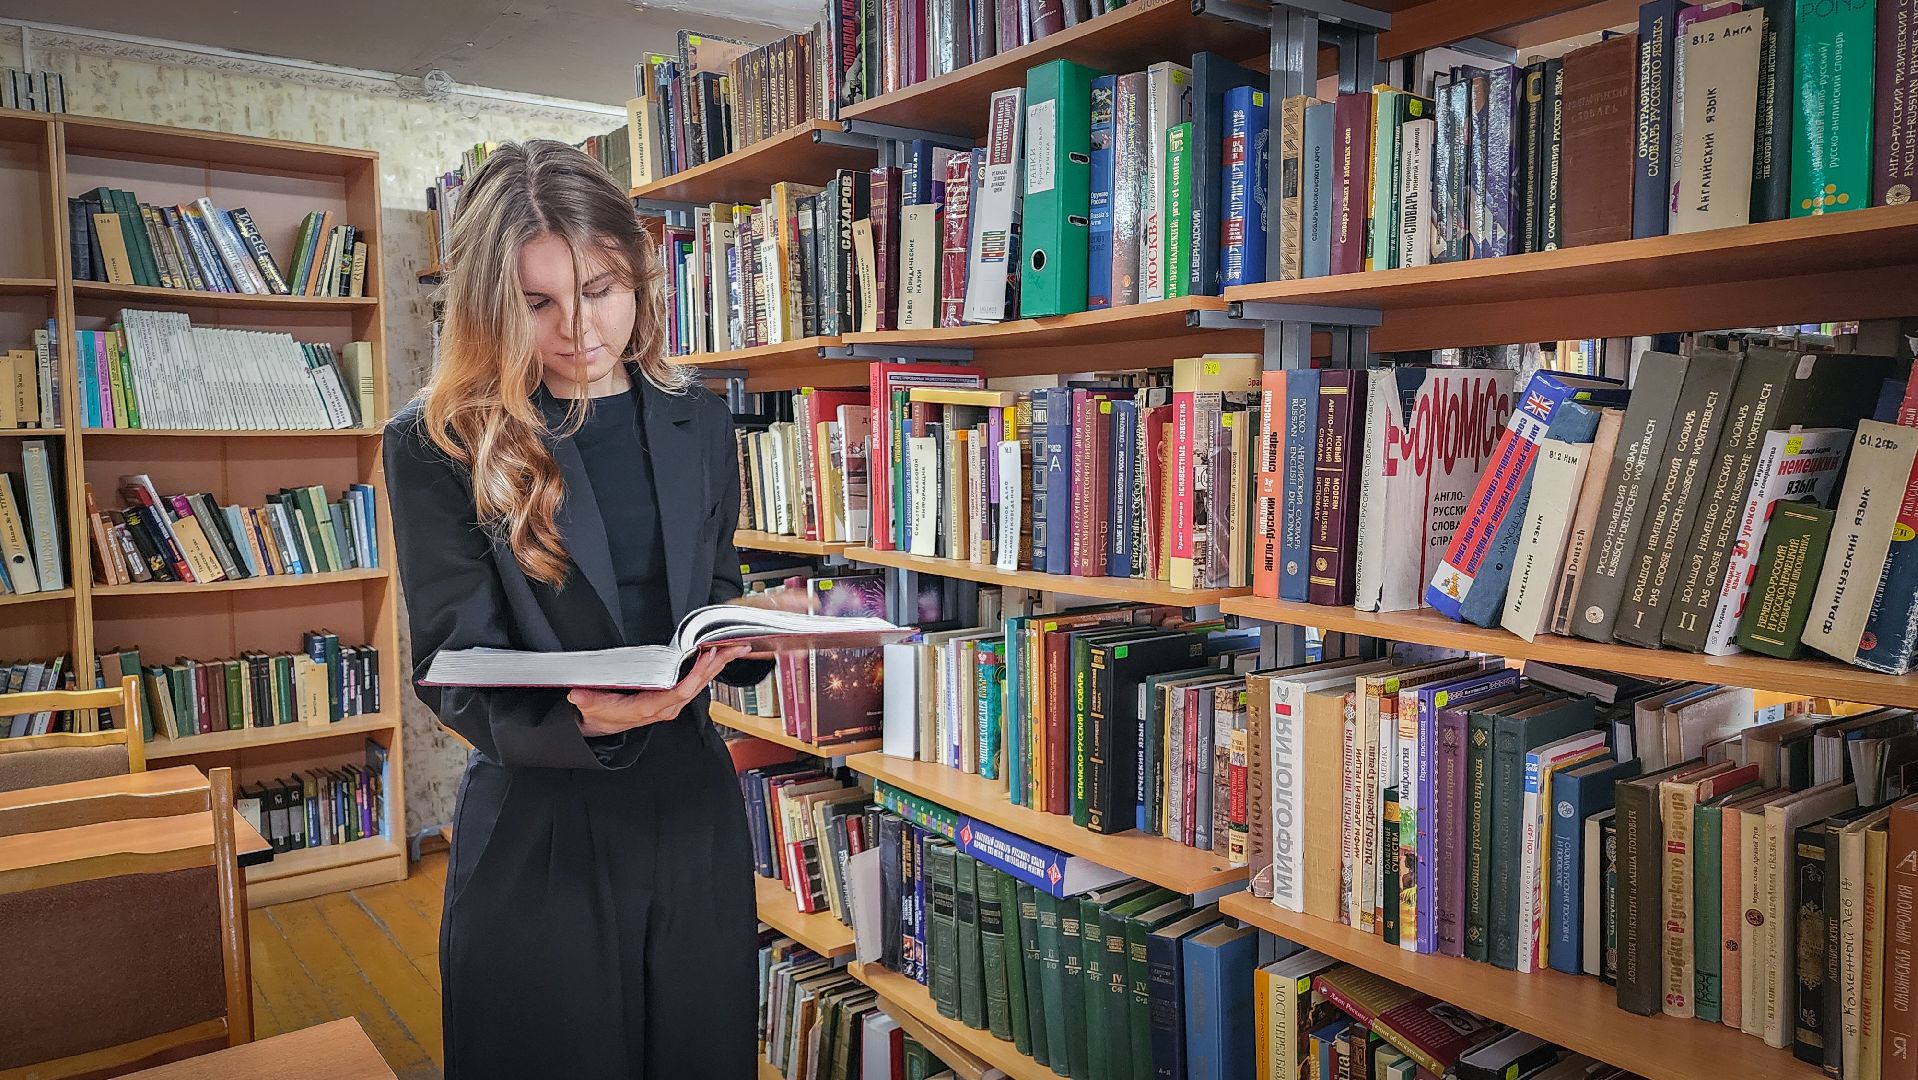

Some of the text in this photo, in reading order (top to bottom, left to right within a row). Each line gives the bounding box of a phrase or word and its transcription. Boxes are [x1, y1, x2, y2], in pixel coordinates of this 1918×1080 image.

[1692, 32, 1716, 46] 81.2
[1894, 8, 1908, 84] ФИЗИЧЕСКИЙ
[1554, 68, 1564, 95] ЯЗЫКА
[1638, 40, 1652, 158] ОРФОГРАФИЧЕСКИЙ
[1647, 16, 1664, 177] СЛОВАРЬ РУССКОГО ЯЗЫКА
[1763, 31, 1778, 179] THE OXFORD RUSSIAN-ENGLISH DICTIONARY
[1828, 31, 1845, 169] русско-английский словарь
[1553, 99, 1563, 141] РУССКОГО
[1888, 86, 1905, 178] АНГЛО-РУССКИЙ
[1903, 79, 1918, 177] ENGLISH-RUSSIAN
[1172, 155, 1181, 186] contra
[841, 175, 852, 250] САХАРОВ
[1190, 209, 1201, 283] В.И.ВЕРНАДСКИЙ
[1339, 212, 1350, 243] Словарь
[1403, 192, 1419, 268] РАТКИЙ СЛОВАРЬ
[1548, 202, 1557, 238] СЛОВАРЬ
[1147, 212, 1159, 289] МОСКВА
[1083, 408, 1093, 460] БИБЛИОТЕК
[1266, 431, 1279, 473] словарь
[1325, 398, 1336, 463] АНГЛО-РУССКИЙ
[1335, 435, 1343, 463] НОВЫЙ
[1505, 424, 1541, 491] АНГЛО-РУССКИЙ
[1082, 462, 1091, 502] ИСТОРИЯ
[1177, 445, 1187, 497] НЕИЗВЕСТНЫЕ
[1286, 398, 1299, 550] RUSSIAN ENGLISH DICTIONARY
[1313, 476, 1323, 521] DICTIONARY
[1331, 477, 1341, 510] MODERN
[1434, 491, 1466, 502] АНГЛО-
[1595, 441, 1640, 575] РУССКО-НЕМЕЦКИЙ СЛОВАРЬ
[1607, 418, 1657, 577] RUSSISCH-DEUTSCHES WÖRTERBUCH
[1632, 409, 1698, 603] БОЛЬШОЙ НЕМЕЦКО-РУССКИЙ СЛОВАРЬ
[1647, 390, 1718, 607] DAS GROSSE DEUTSCH-RUSSISCHE WÖRTERBUCH
[1681, 404, 1751, 603] БОЛЬШОЙ НЕМЕЦКО-РУССКИЙ СЛОВАРЬ
[1696, 382, 1774, 609] DAS GROSSE DEUTSCH-RUSSISCHE WÖRTERBUCH
[1263, 497, 1277, 572] англо-русский
[1320, 477, 1332, 541] ENGLISH-RUSSIAN
[1358, 479, 1371, 550] АНГЛО-РУССКИЙ
[1432, 505, 1467, 517] РУССКИ
[1730, 499, 1761, 560] 30 уроков
[1567, 529, 1586, 572] Deutsch
[1757, 544, 1788, 629] НЕМЕЦКО-РУССКИЙ
[1768, 538, 1800, 623] РУССКО-НЕМЕЦКИЙ
[1777, 534, 1812, 634] СЛОВАРЬ ДЛЯ ШКОЛЬНИКА
[1076, 670, 1085, 801] ИСПАНСКО-РУССКИЙ СЛОВАРЬ
[1137, 721, 1146, 802] ГРЕЧЕСКИЙ ЯЗЫК
[1380, 744, 1390, 786] АМЕРИКА
[1418, 719, 1428, 782] Город пословиц
[1275, 716, 1295, 899] МИФОЛОГИЯ
[1354, 747, 1364, 859] МИФЫ ДРЕВНЕЙ ГРЕЦИИ
[1399, 746, 1414, 801] Мифология
[1383, 826, 1392, 875] ВОЛШЕБНЫЕ
[1391, 831, 1400, 873] СУЩЕСТВА
[1470, 758, 1485, 914] пословицы русского народа
[1627, 810, 1638, 985] ДОБРЫНЯ НИКИТИЧ АЛЕША ПОПОВИЧ
[1862, 881, 1876, 1038] РУССКИЙ СОВЕТСКИЙ ФОЛЬКЛОР
[1893, 884, 1913, 1012] СЛАВЯНСКАЯ МИФОЛОГИЯ
[1275, 983, 1286, 1018] МОСТ
[1275, 1021, 1286, 1056] ЧЕРЕЗ
